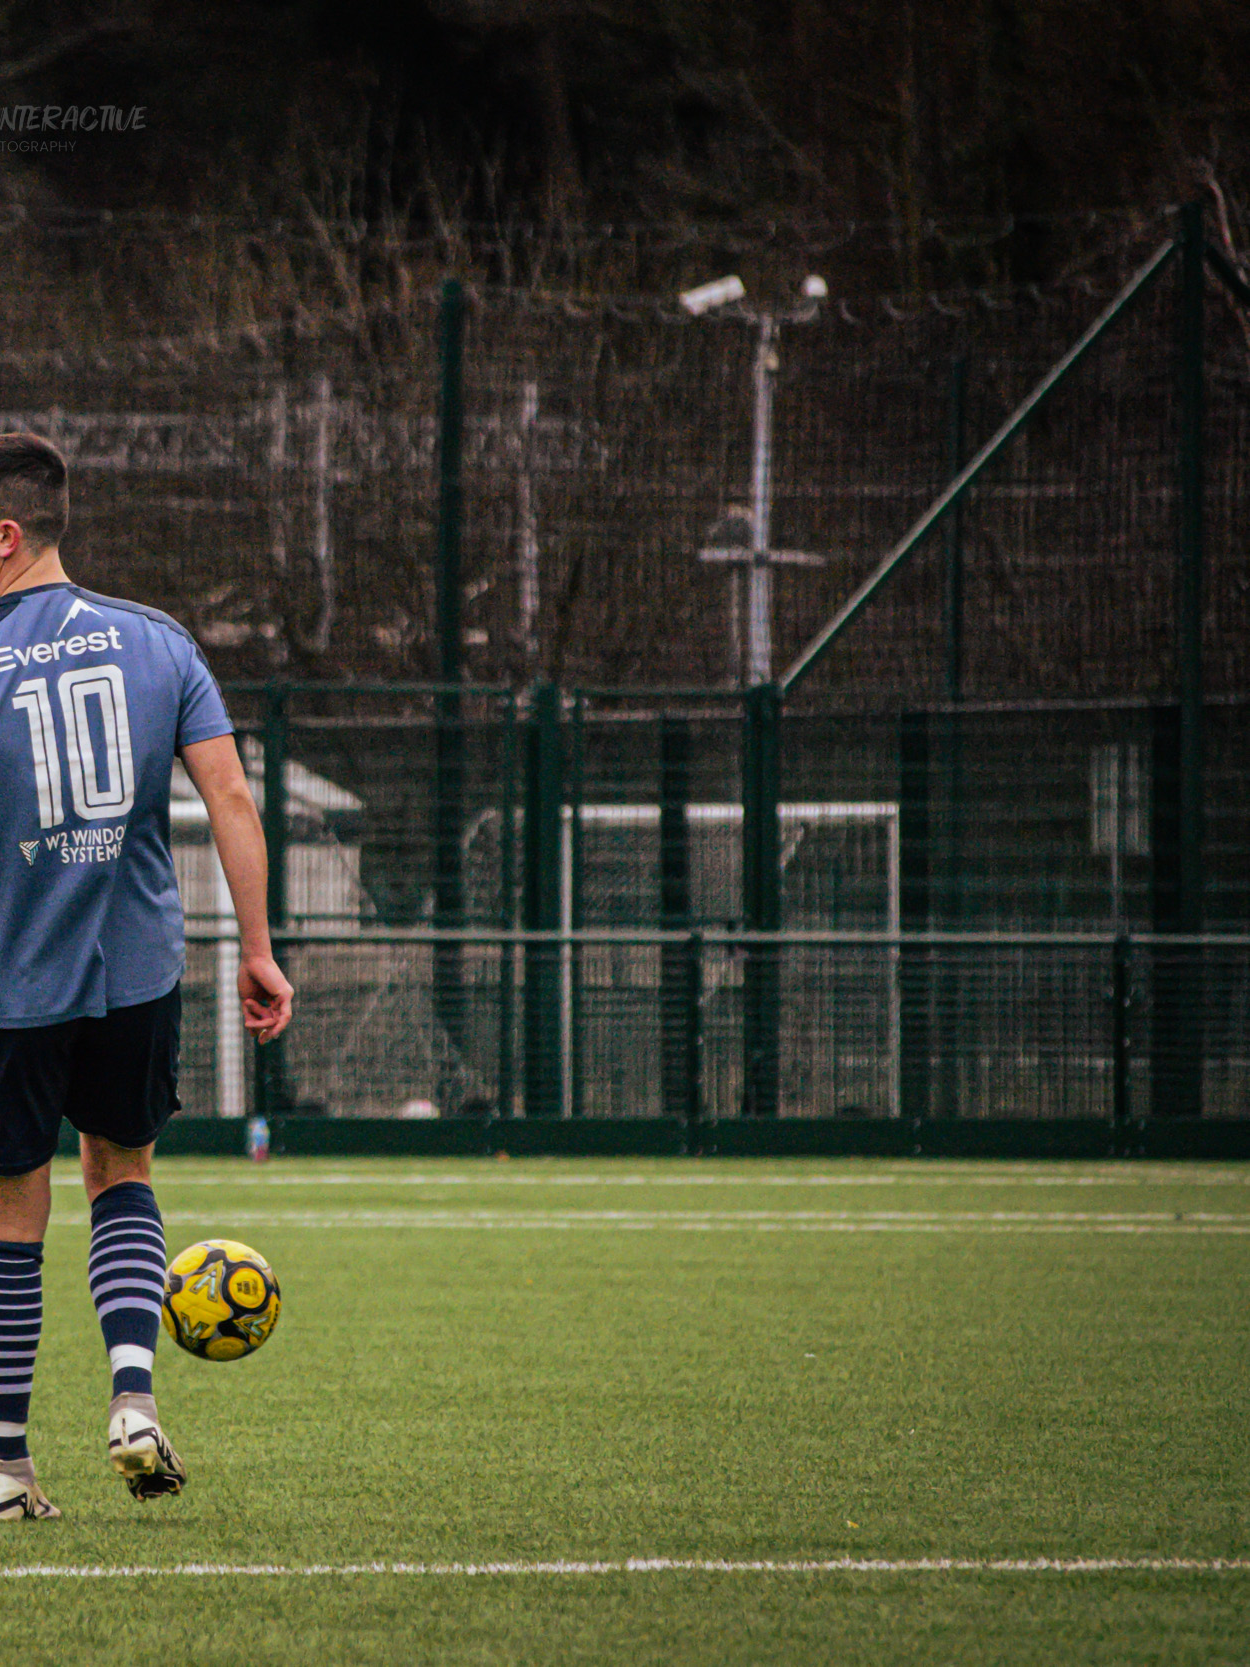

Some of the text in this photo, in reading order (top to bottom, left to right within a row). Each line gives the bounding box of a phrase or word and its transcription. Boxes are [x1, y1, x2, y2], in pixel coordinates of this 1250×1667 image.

[12, 664, 135, 829] 10
[45, 823, 127, 851] W2 WINDO
